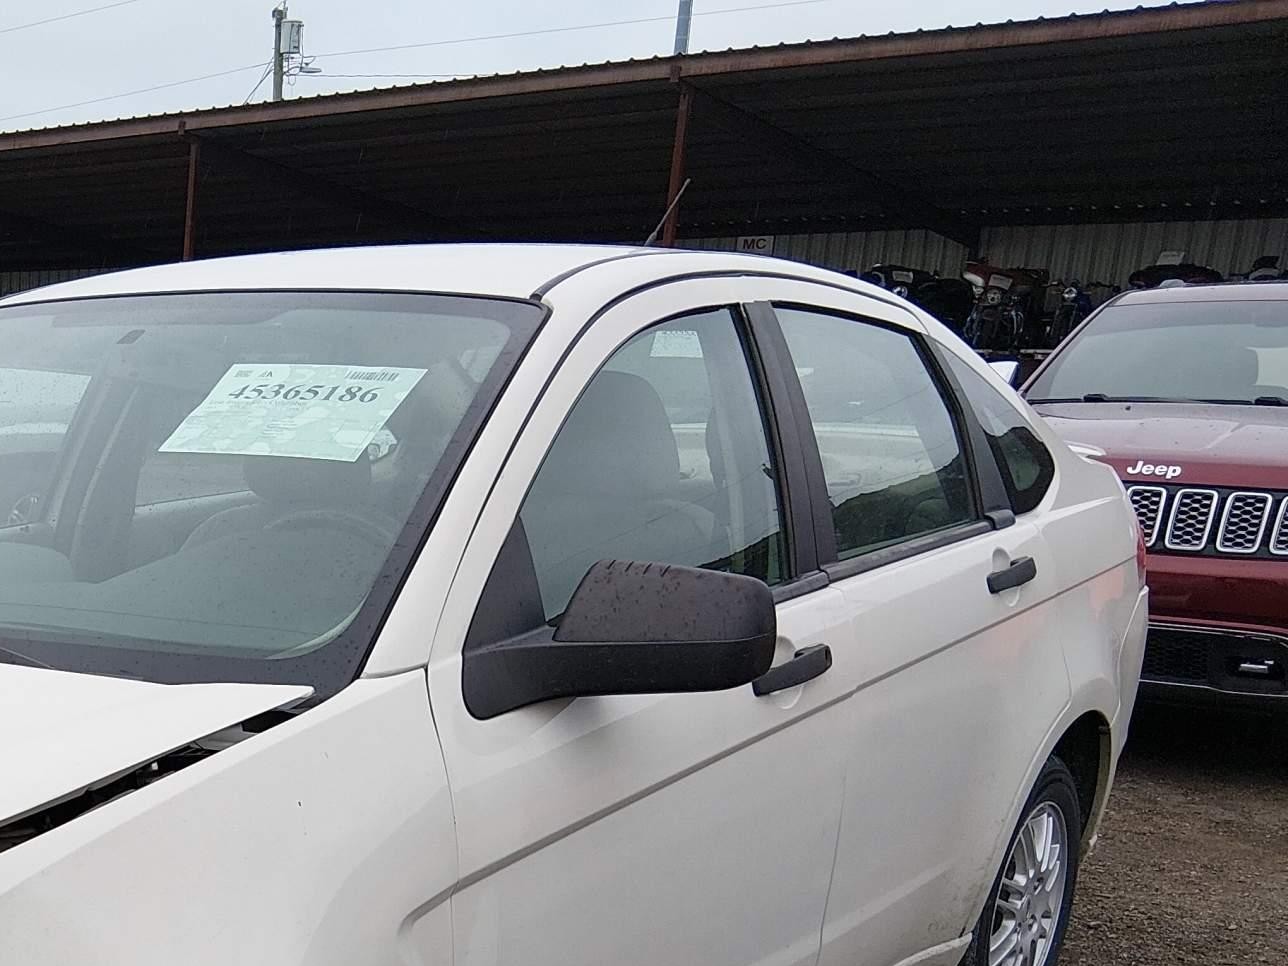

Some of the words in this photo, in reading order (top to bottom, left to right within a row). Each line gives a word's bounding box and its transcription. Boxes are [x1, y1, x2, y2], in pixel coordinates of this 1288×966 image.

[743, 238, 767, 250] MC
[228, 383, 385, 404] 45365186
[1126, 460, 1182, 480] Jeep
